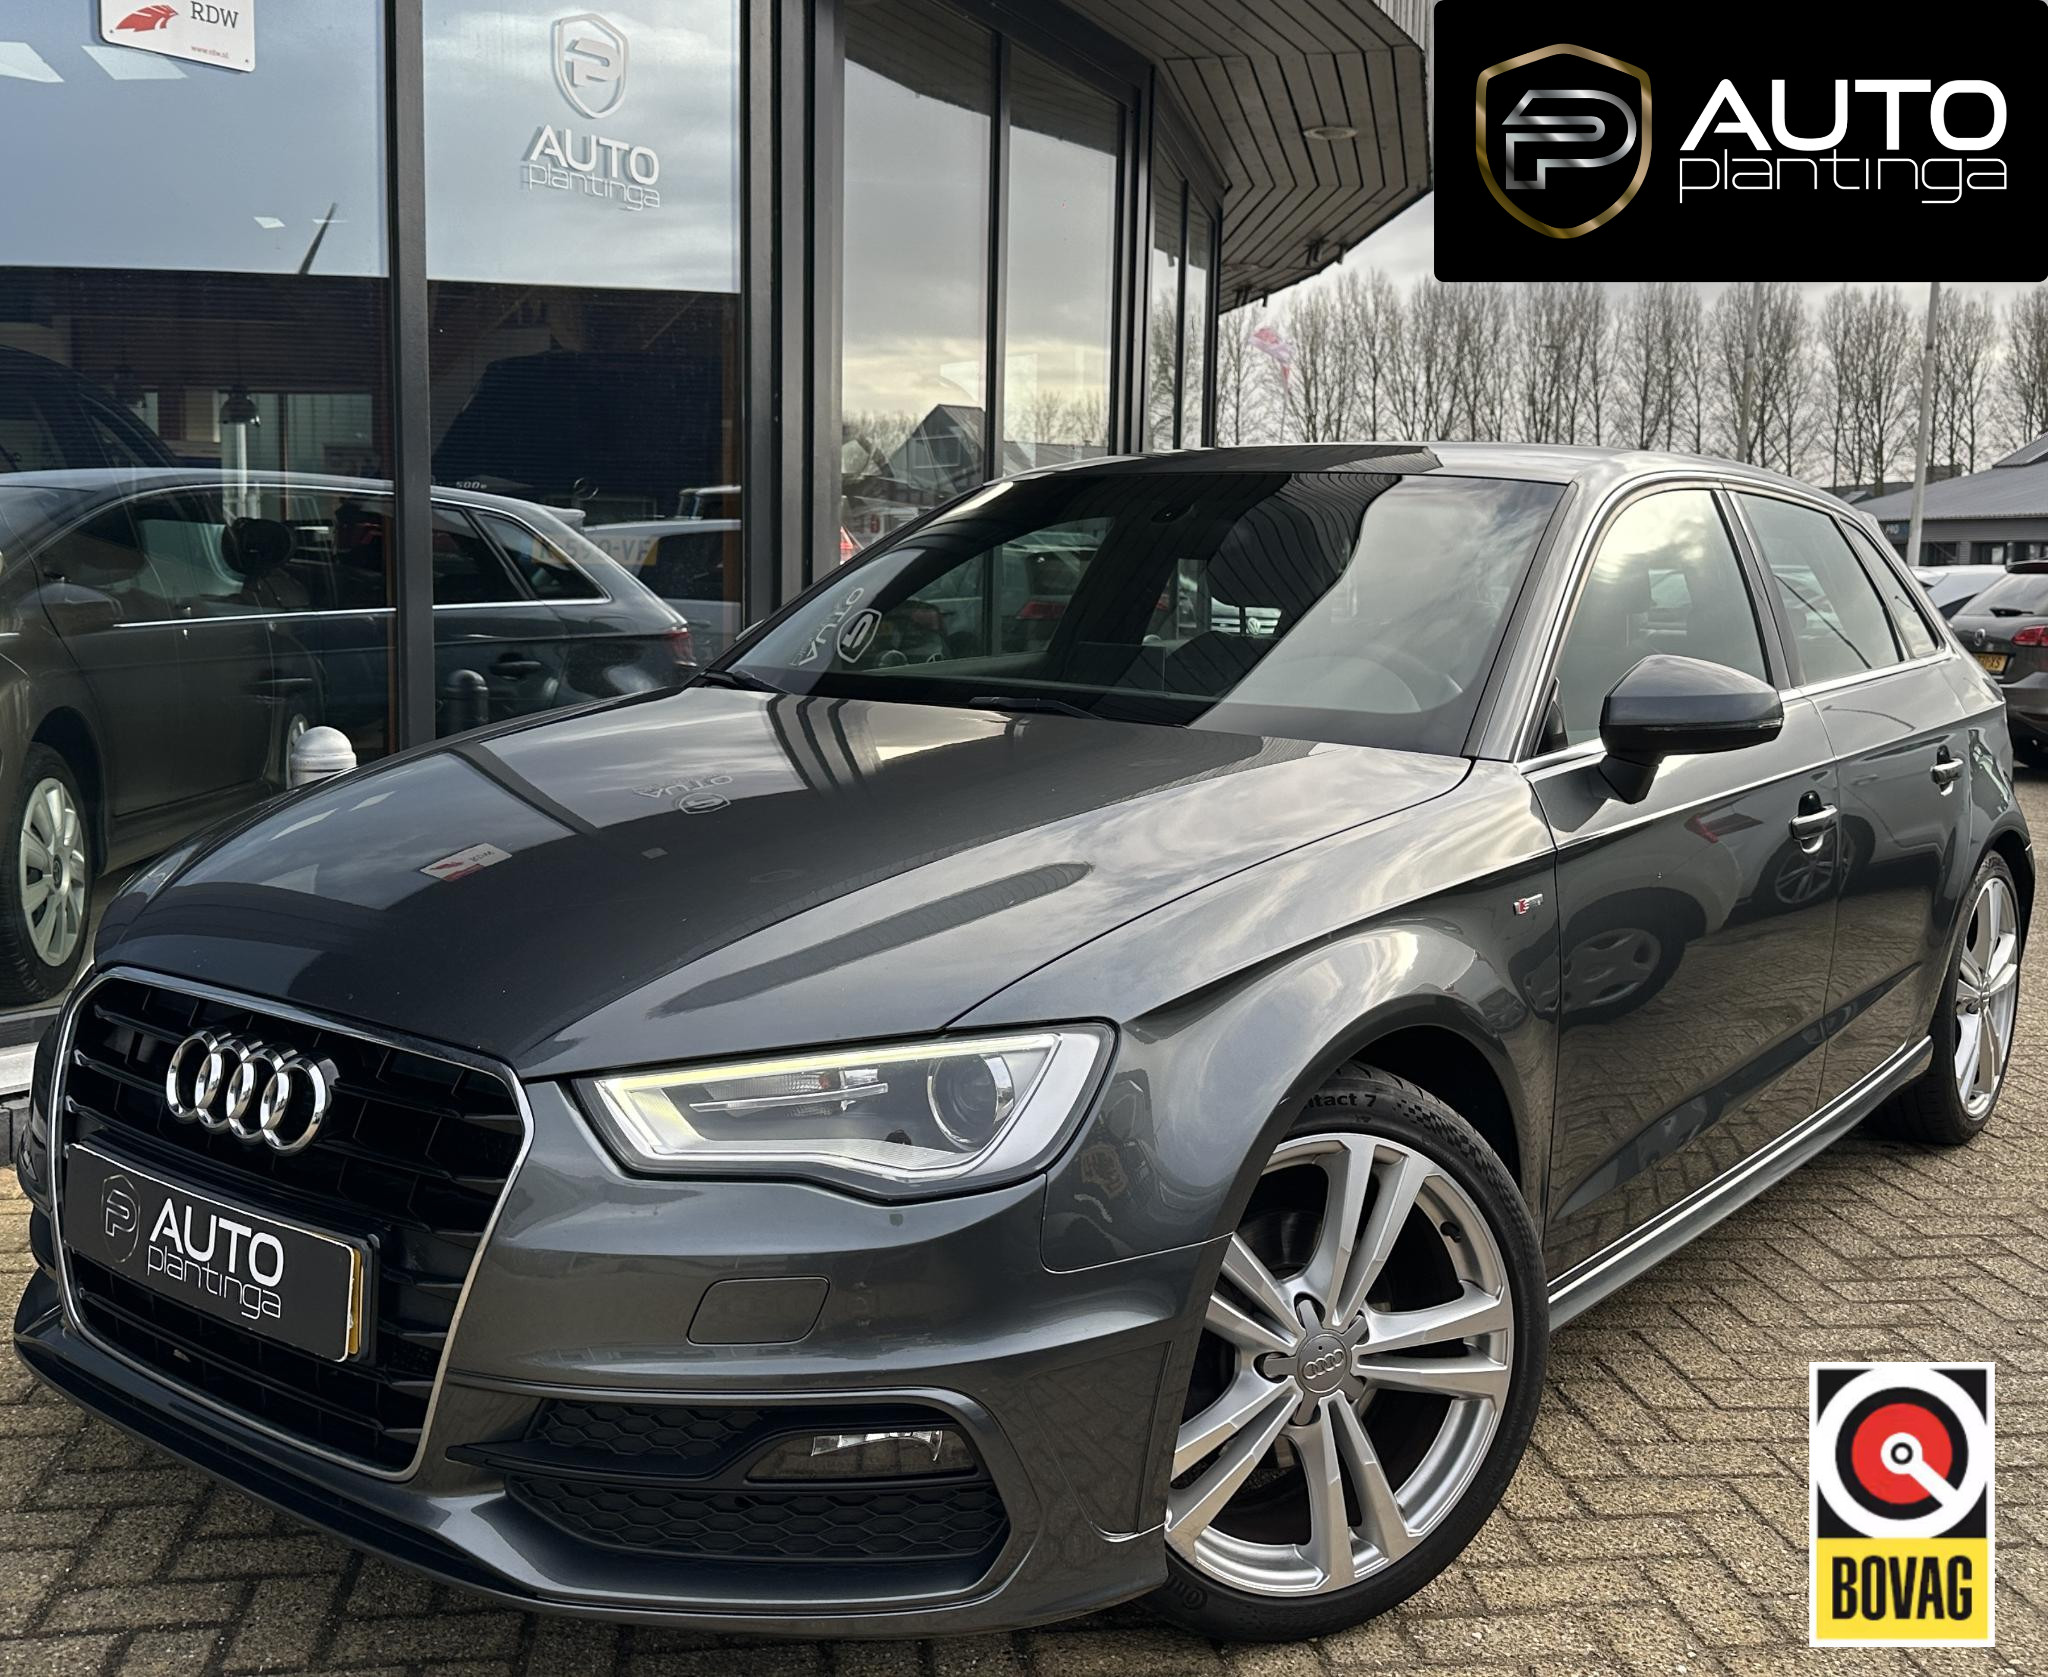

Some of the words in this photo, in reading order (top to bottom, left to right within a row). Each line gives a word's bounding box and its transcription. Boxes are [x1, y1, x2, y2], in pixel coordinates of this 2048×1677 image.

[191, 1, 239, 29] RDW
[529, 125, 660, 185] AUTO
[528, 163, 661, 212] plantinga
[1364, 1093, 1377, 1108] 7
[150, 1197, 284, 1287] AUTO
[147, 1244, 282, 1320] plantinga
